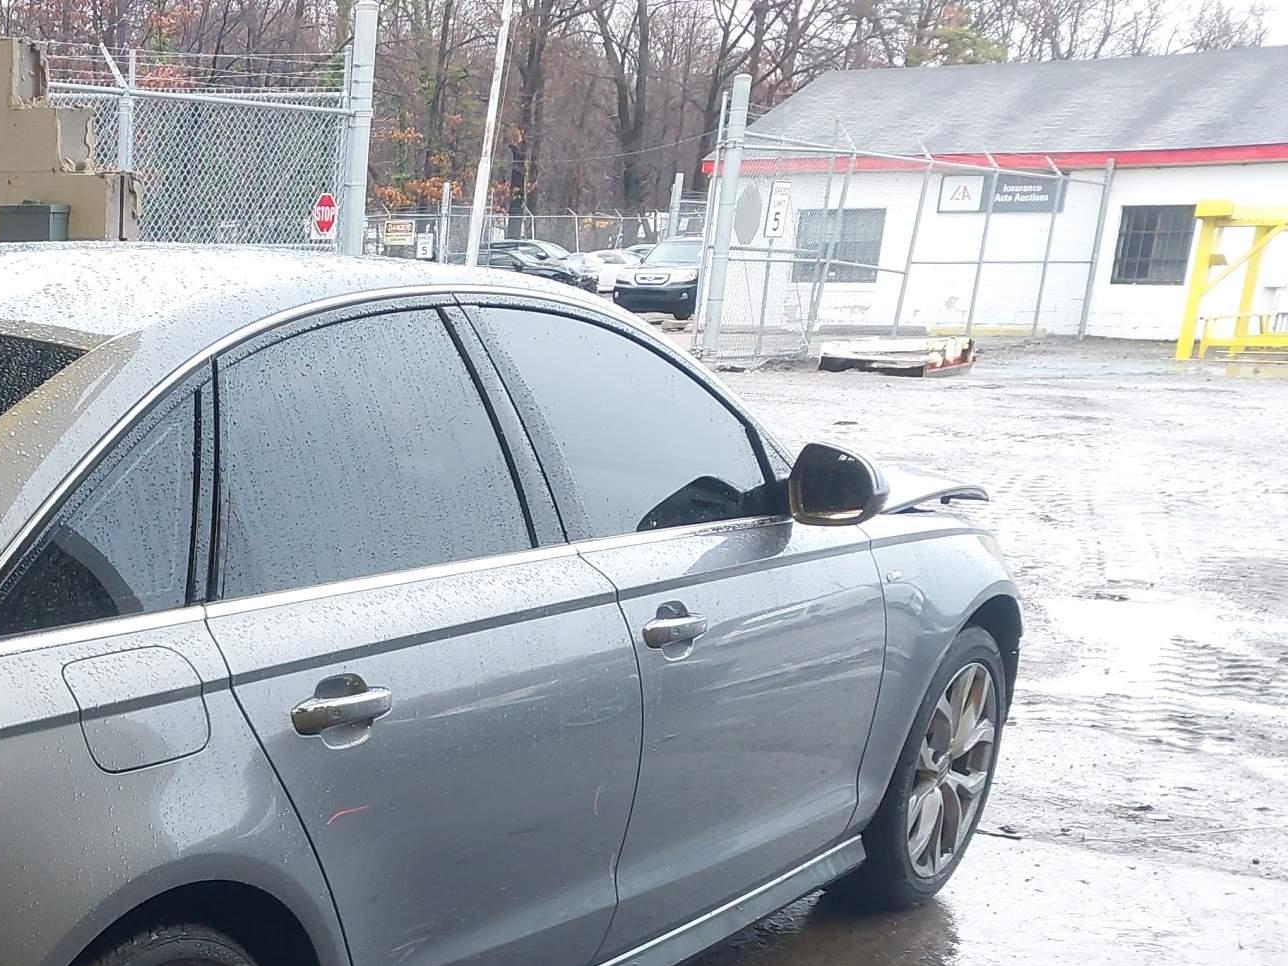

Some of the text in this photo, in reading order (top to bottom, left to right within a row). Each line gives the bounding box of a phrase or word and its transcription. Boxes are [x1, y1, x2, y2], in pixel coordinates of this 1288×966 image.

[1003, 184, 1042, 193] Insurance
[994, 193, 1049, 202] Auto Auctions
[315, 206, 334, 221] STOP
[772, 212, 781, 231] 5
[422, 246, 428, 256] 5
